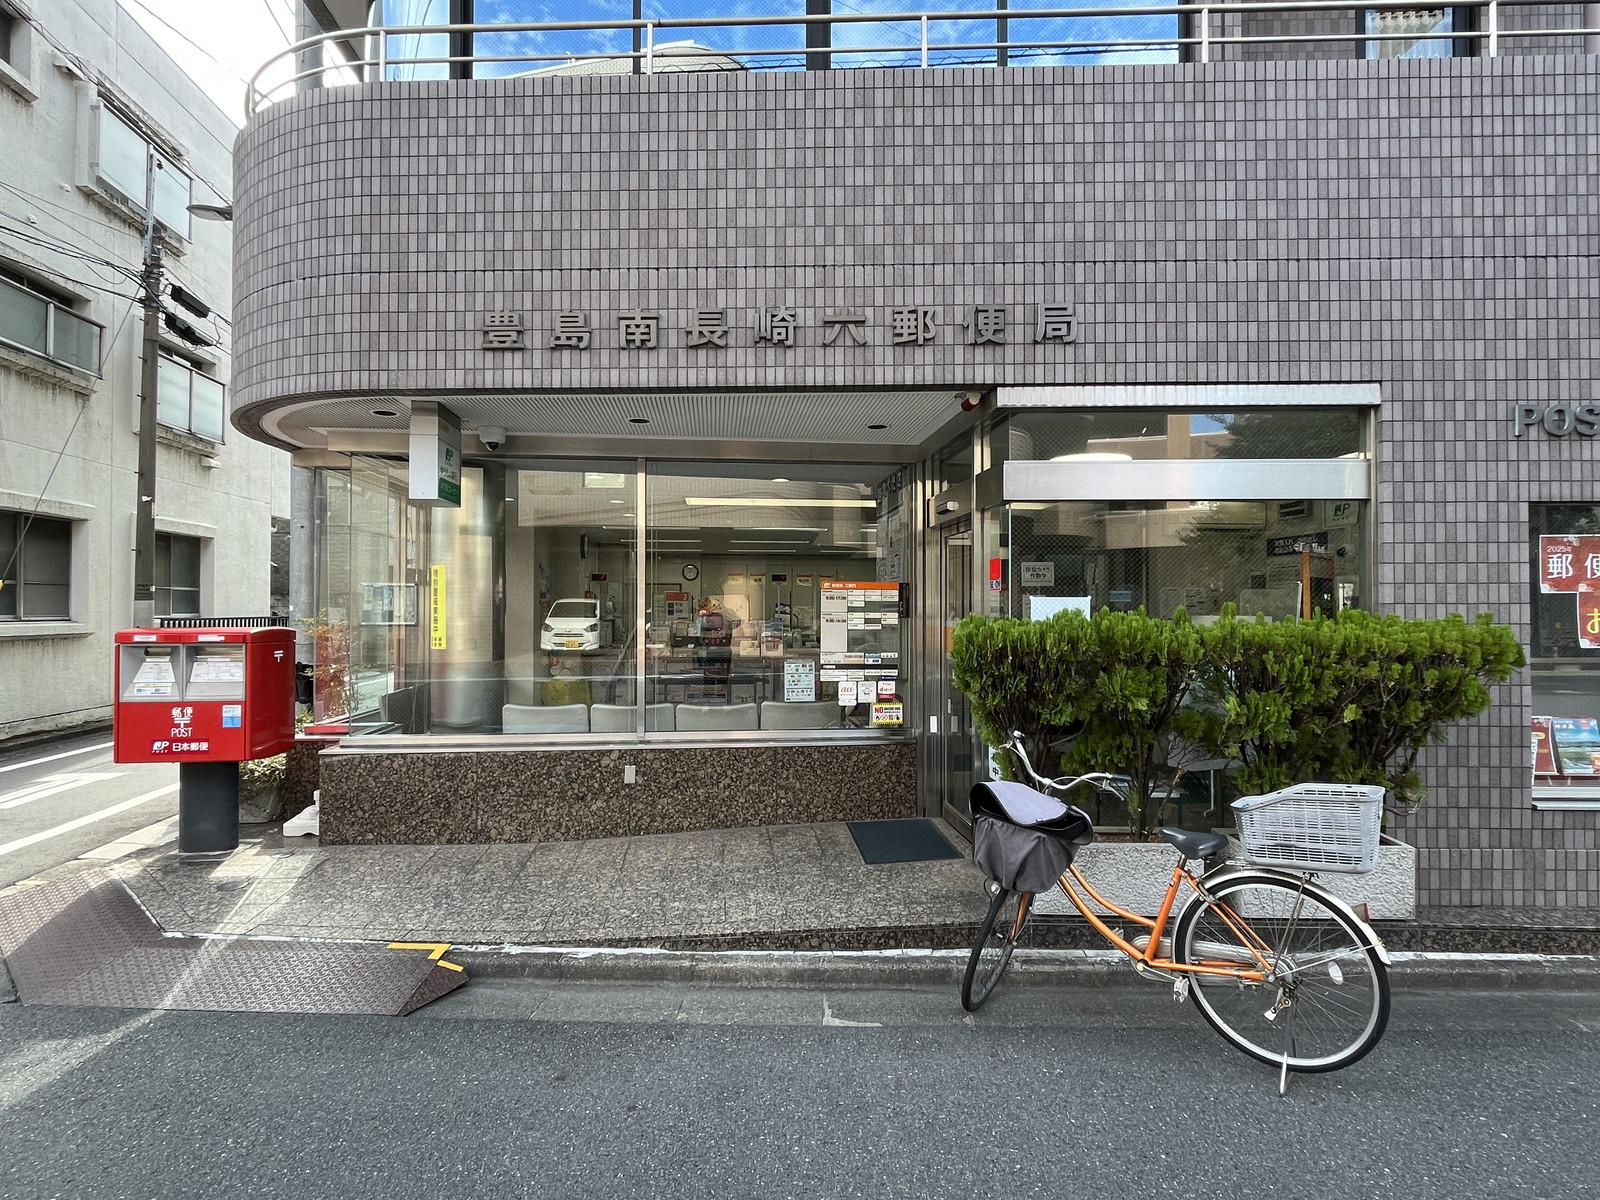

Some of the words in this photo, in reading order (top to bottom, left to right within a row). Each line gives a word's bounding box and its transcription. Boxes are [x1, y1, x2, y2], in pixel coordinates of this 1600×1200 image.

[482, 303, 1078, 350] 豊島南長崎六郵便局
[1514, 404, 1600, 436] POS
[171, 706, 193, 718] 郵便
[171, 727, 193, 737] POST
[172, 742, 208, 752] 日本郵便
